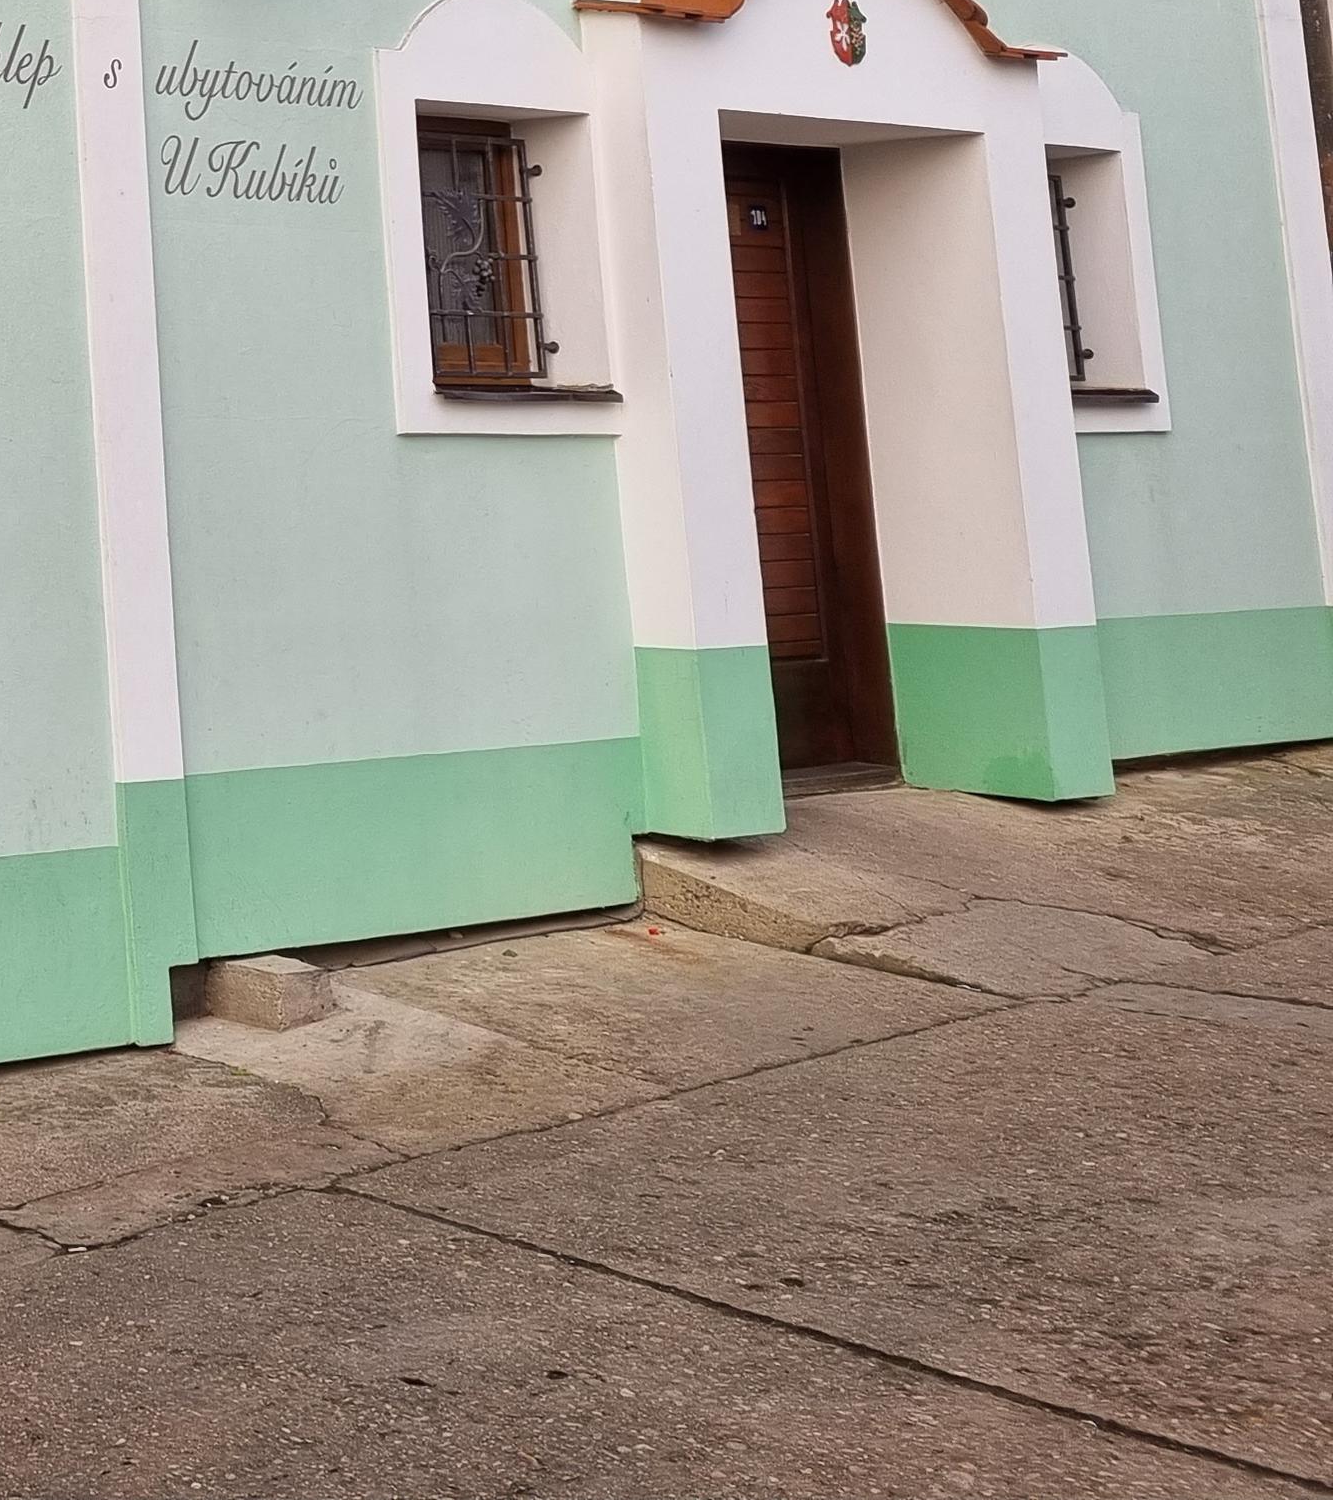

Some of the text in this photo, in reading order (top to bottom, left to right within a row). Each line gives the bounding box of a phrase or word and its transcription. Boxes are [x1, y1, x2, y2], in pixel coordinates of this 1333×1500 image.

[103, 58, 122, 89] s
[155, 39, 364, 121] ubytováním
[160, 135, 345, 204] U Kubíků
